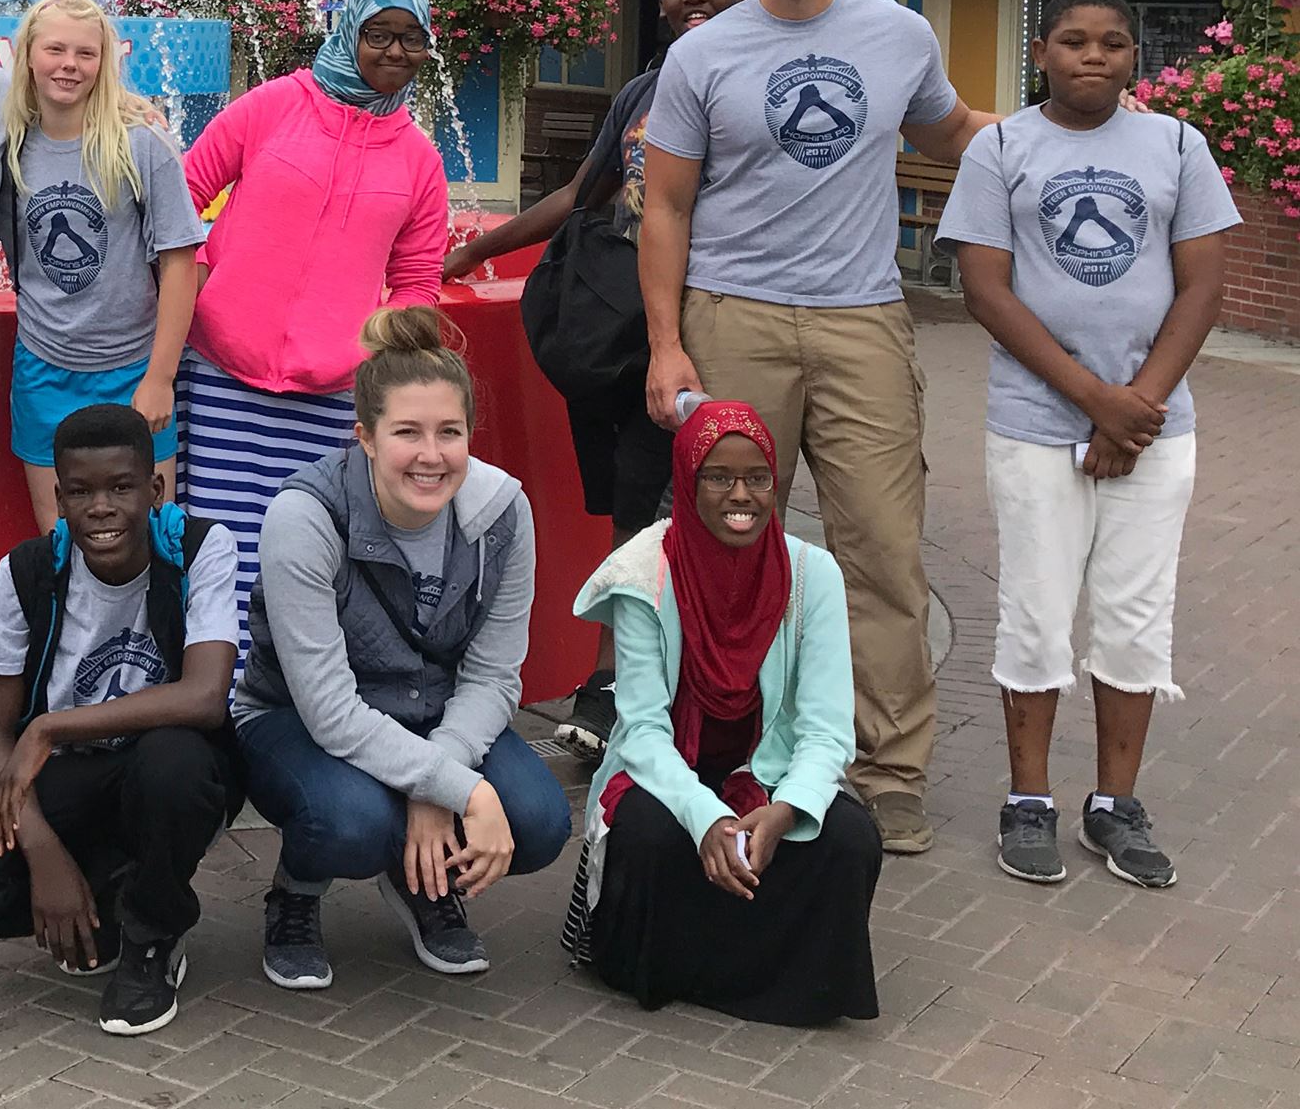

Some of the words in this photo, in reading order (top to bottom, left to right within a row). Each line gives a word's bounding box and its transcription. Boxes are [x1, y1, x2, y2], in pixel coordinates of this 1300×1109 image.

[772, 81, 792, 97] TEEN
[792, 72, 857, 92] EMPOWERMENT
[784, 129, 833, 142] HOPKINS
[805, 148, 829, 156] 2017
[1046, 190, 1068, 206] TEEN
[1068, 184, 1138, 206] EMPOWERMENT
[1060, 241, 1113, 258] HOPKINS
[1115, 243, 1130, 254] PD
[1083, 264, 1110, 272] 2017
